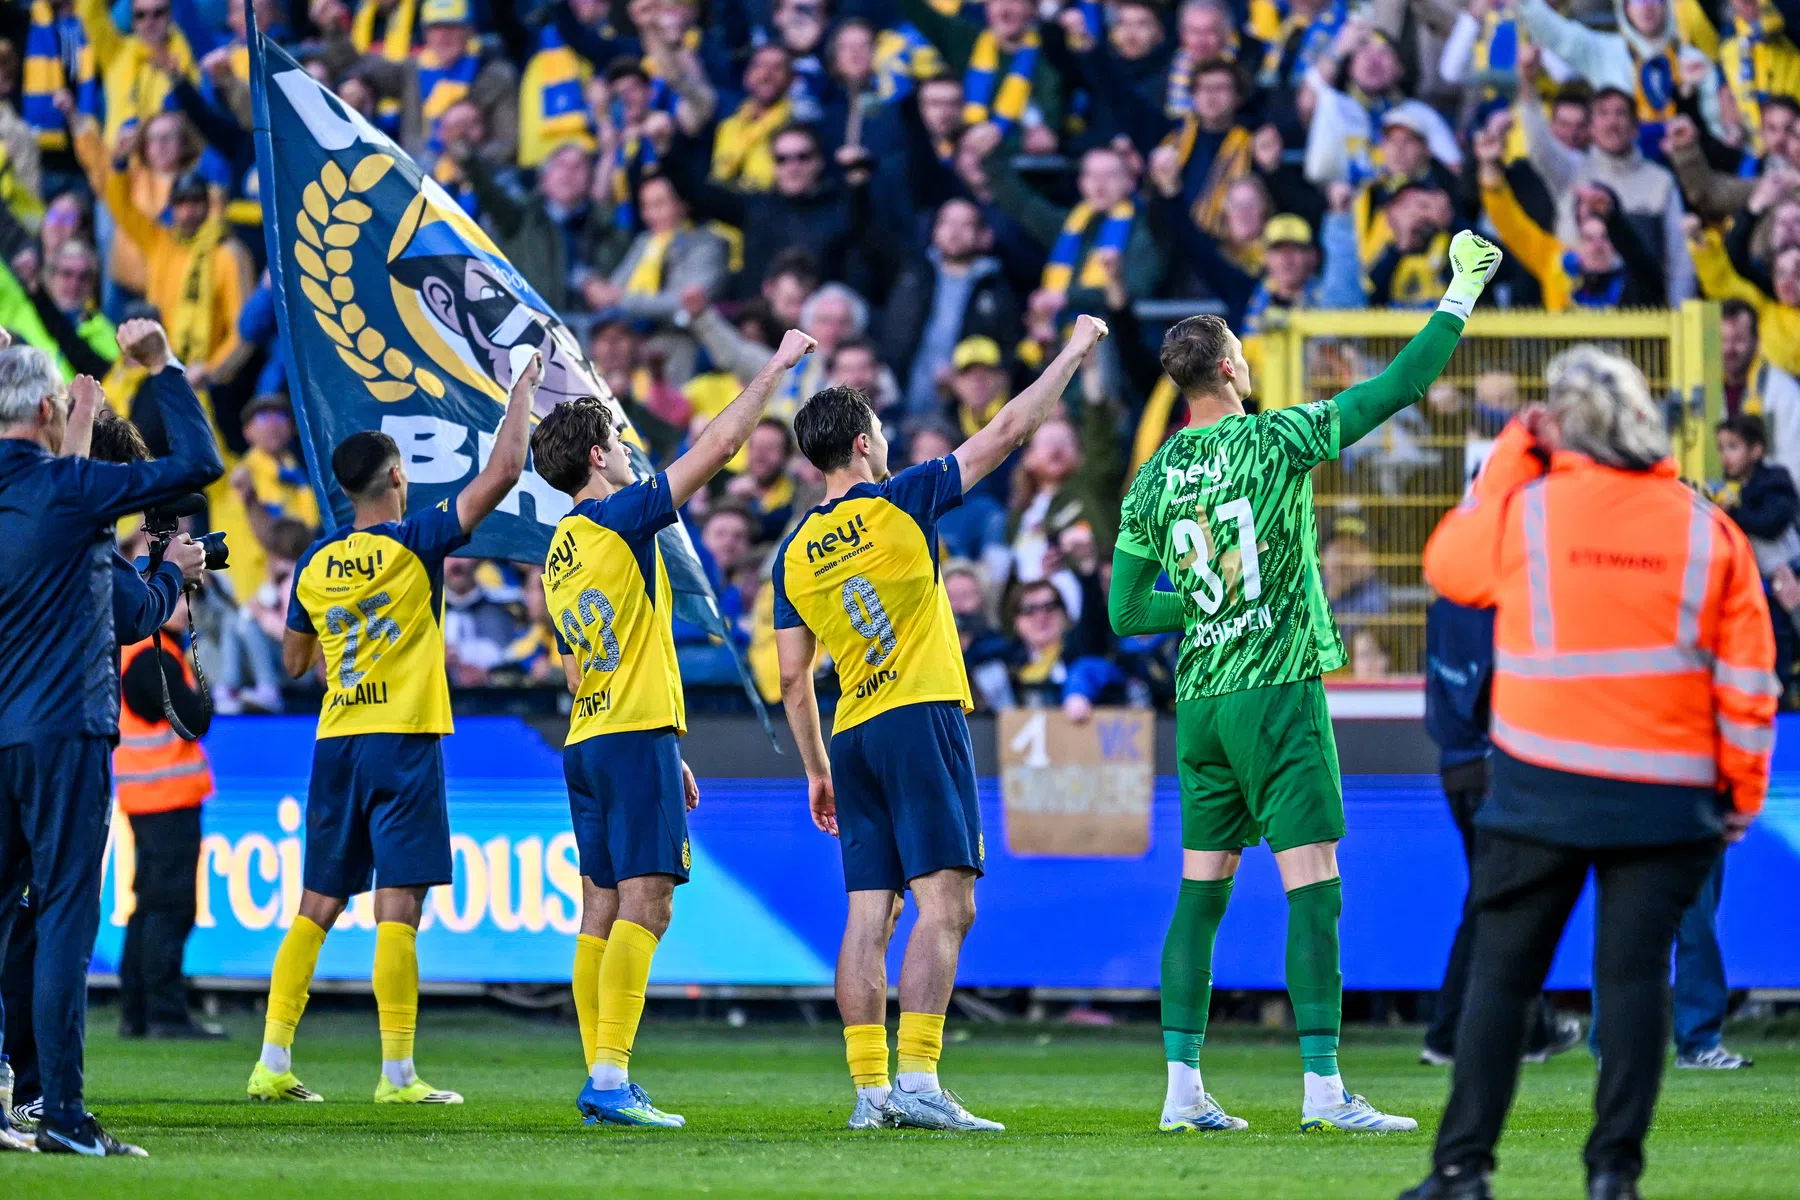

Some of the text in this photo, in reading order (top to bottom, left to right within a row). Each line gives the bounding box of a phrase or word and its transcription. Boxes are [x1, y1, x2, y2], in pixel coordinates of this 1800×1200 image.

[1167, 447, 1230, 490] hey!
[1170, 480, 1233, 506] mobile internet
[807, 514, 868, 563] hey!
[814, 541, 874, 578] mobile internet
[1172, 497, 1262, 615] 37
[326, 550, 383, 581] hey!
[326, 591, 402, 689] 25
[842, 575, 897, 667] 9
